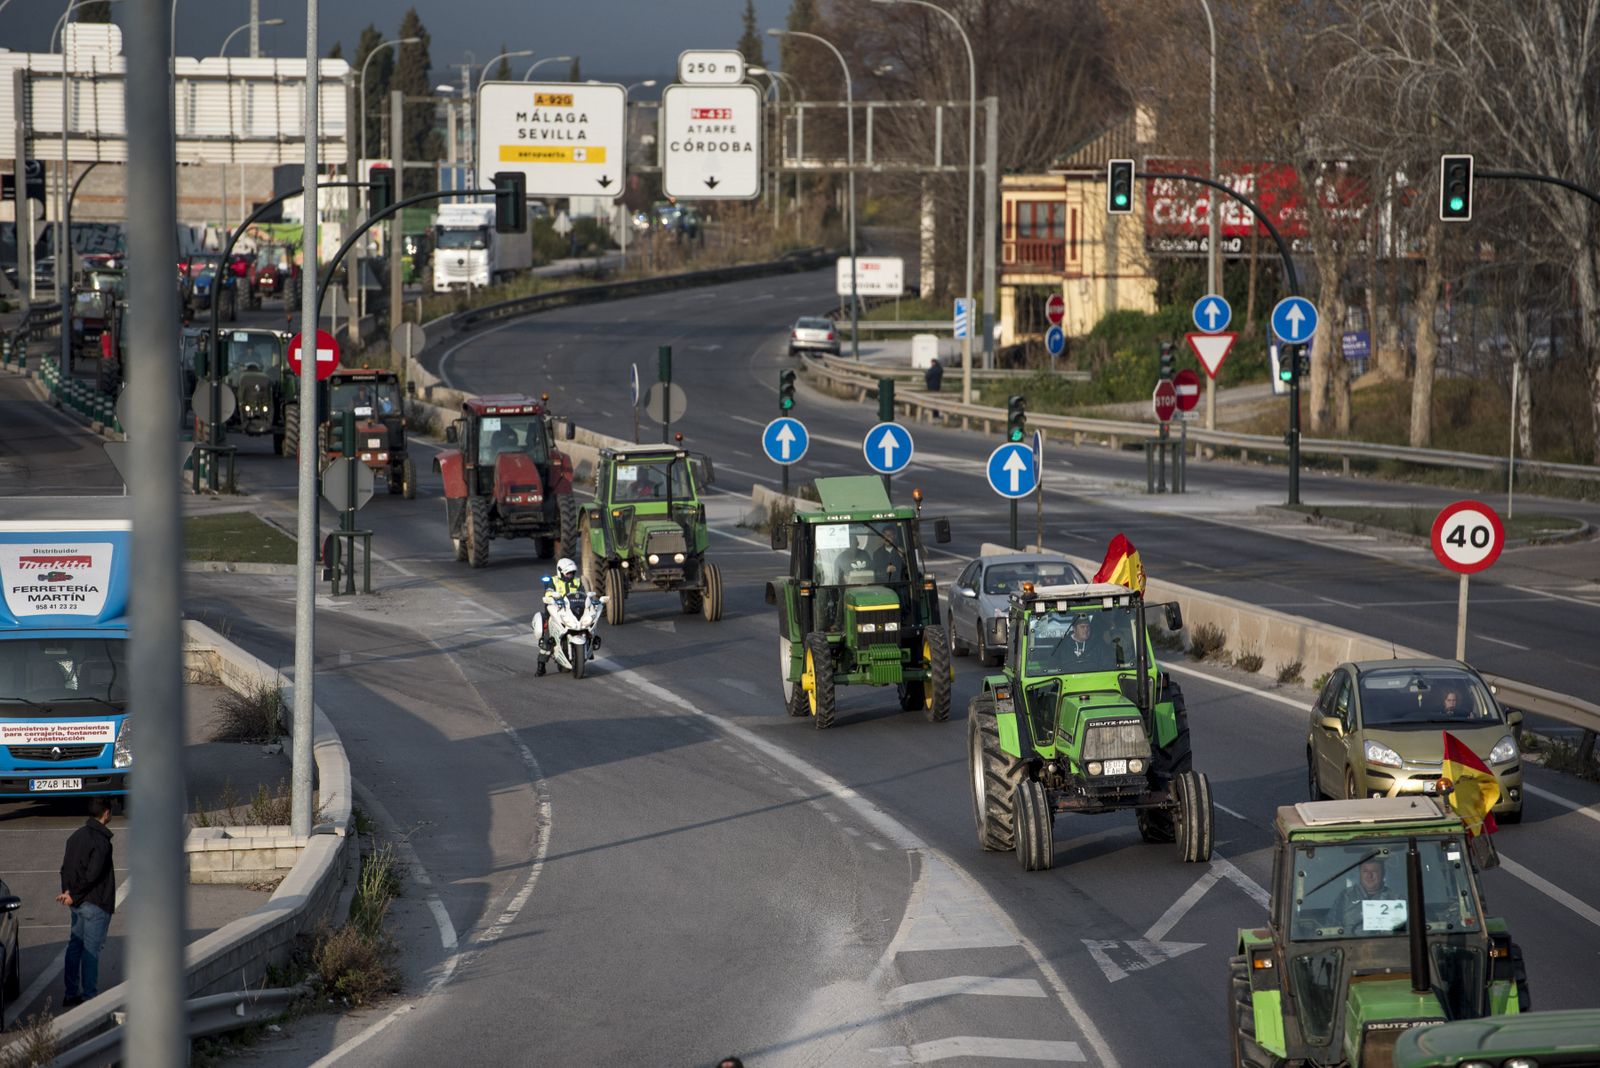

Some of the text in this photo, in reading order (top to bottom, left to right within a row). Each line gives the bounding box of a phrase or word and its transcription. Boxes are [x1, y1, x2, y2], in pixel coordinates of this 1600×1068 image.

[687, 63, 736, 73] 250 m
[516, 108, 588, 123] MÁLAGA
[518, 128, 587, 140] SEVILLA
[687, 125, 737, 134] ATARFE
[670, 139, 752, 152] CÓRDOBA
[518, 151, 566, 159] aeropuerto
[1156, 396, 1175, 408] STOP
[829, 528, 836, 537] 2
[1446, 525, 1490, 549] 40
[12, 584, 99, 594] FERRETERÍA
[28, 592, 85, 602] MARTÍN
[36, 779, 79, 789] 2748 HLN
[1380, 904, 1389, 915] 2
